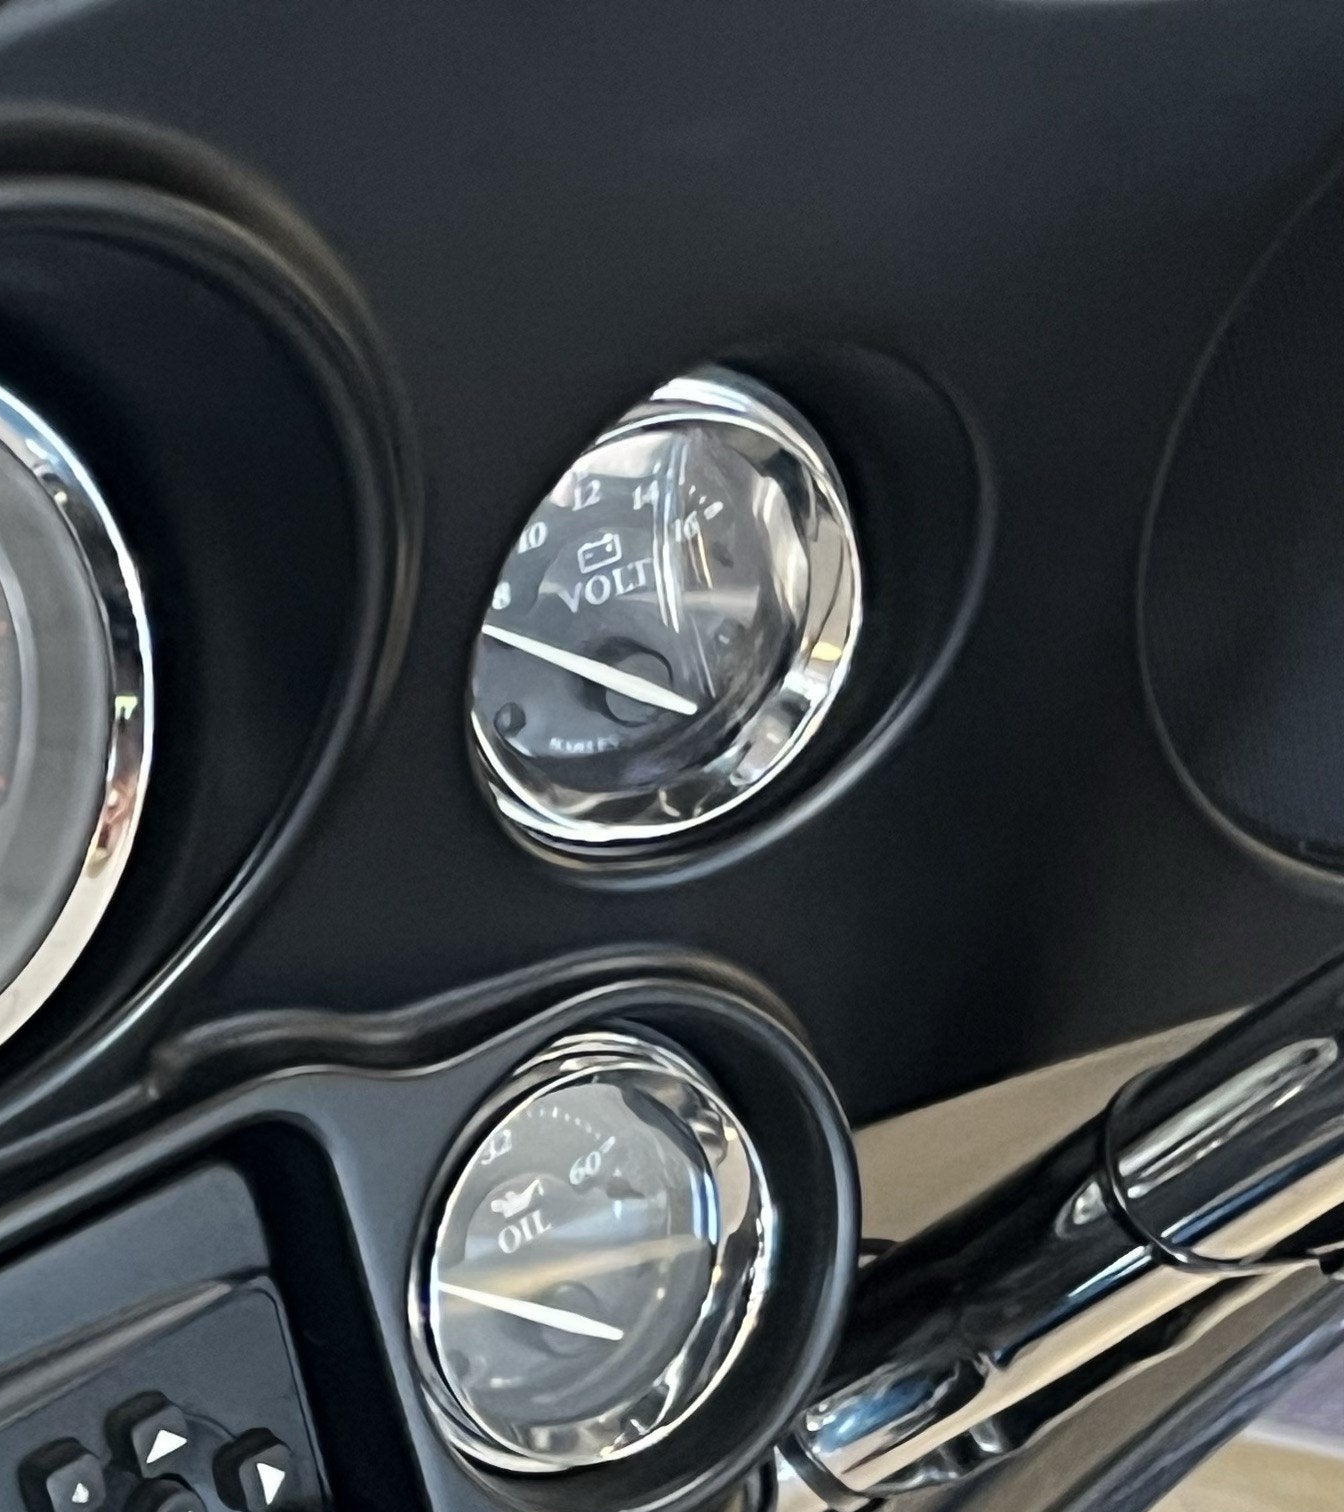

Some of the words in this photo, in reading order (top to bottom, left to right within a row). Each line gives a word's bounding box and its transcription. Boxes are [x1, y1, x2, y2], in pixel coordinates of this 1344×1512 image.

[572, 480, 601, 511] 12
[632, 479, 659, 511] 14
[518, 521, 547, 554] 10
[558, 557, 653, 613] VOLT
[570, 1151, 602, 1185] 60
[497, 1210, 553, 1254] OIL
